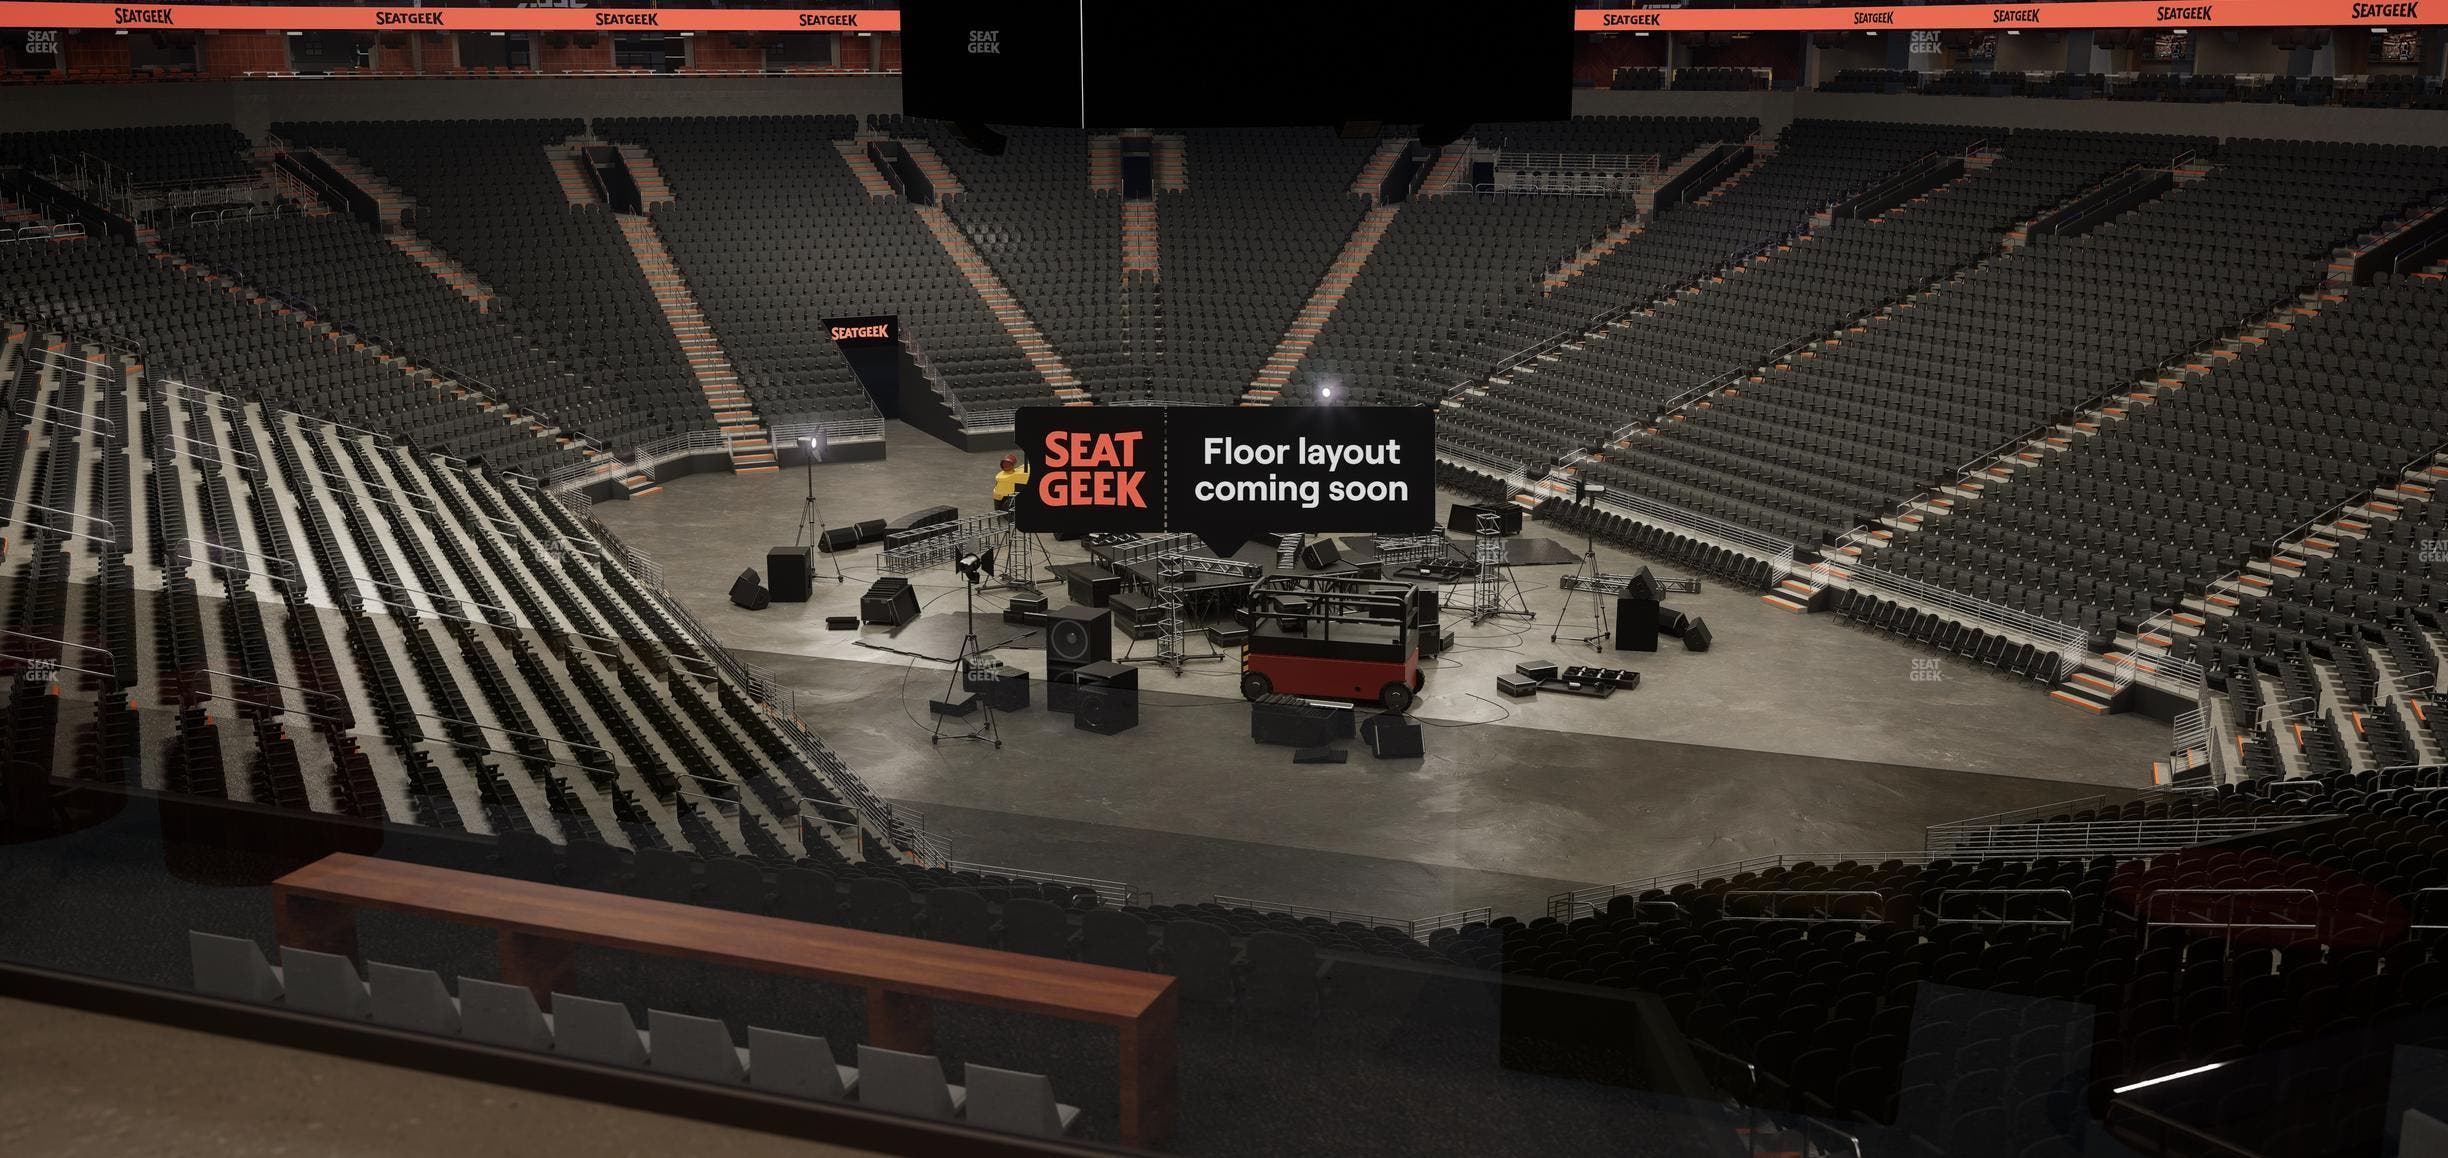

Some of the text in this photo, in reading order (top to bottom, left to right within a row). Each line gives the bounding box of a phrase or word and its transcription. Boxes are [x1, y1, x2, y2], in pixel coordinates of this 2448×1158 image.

[115, 7, 174, 25] SEATGEEK
[1853, 11, 1894, 25] SEATGEEK
[1993, 8, 2041, 24] SEATGEEK
[2156, 5, 2213, 22] SEATGEEK
[2351, 1, 2419, 20] SEATGEEK
[375, 11, 444, 26] SEATGEEK
[595, 12, 659, 26] SEATGEEK
[799, 13, 858, 27] SEATGEEK
[1603, 13, 1661, 26] SEATGEEK
[831, 324, 889, 341] SEATGEEK
